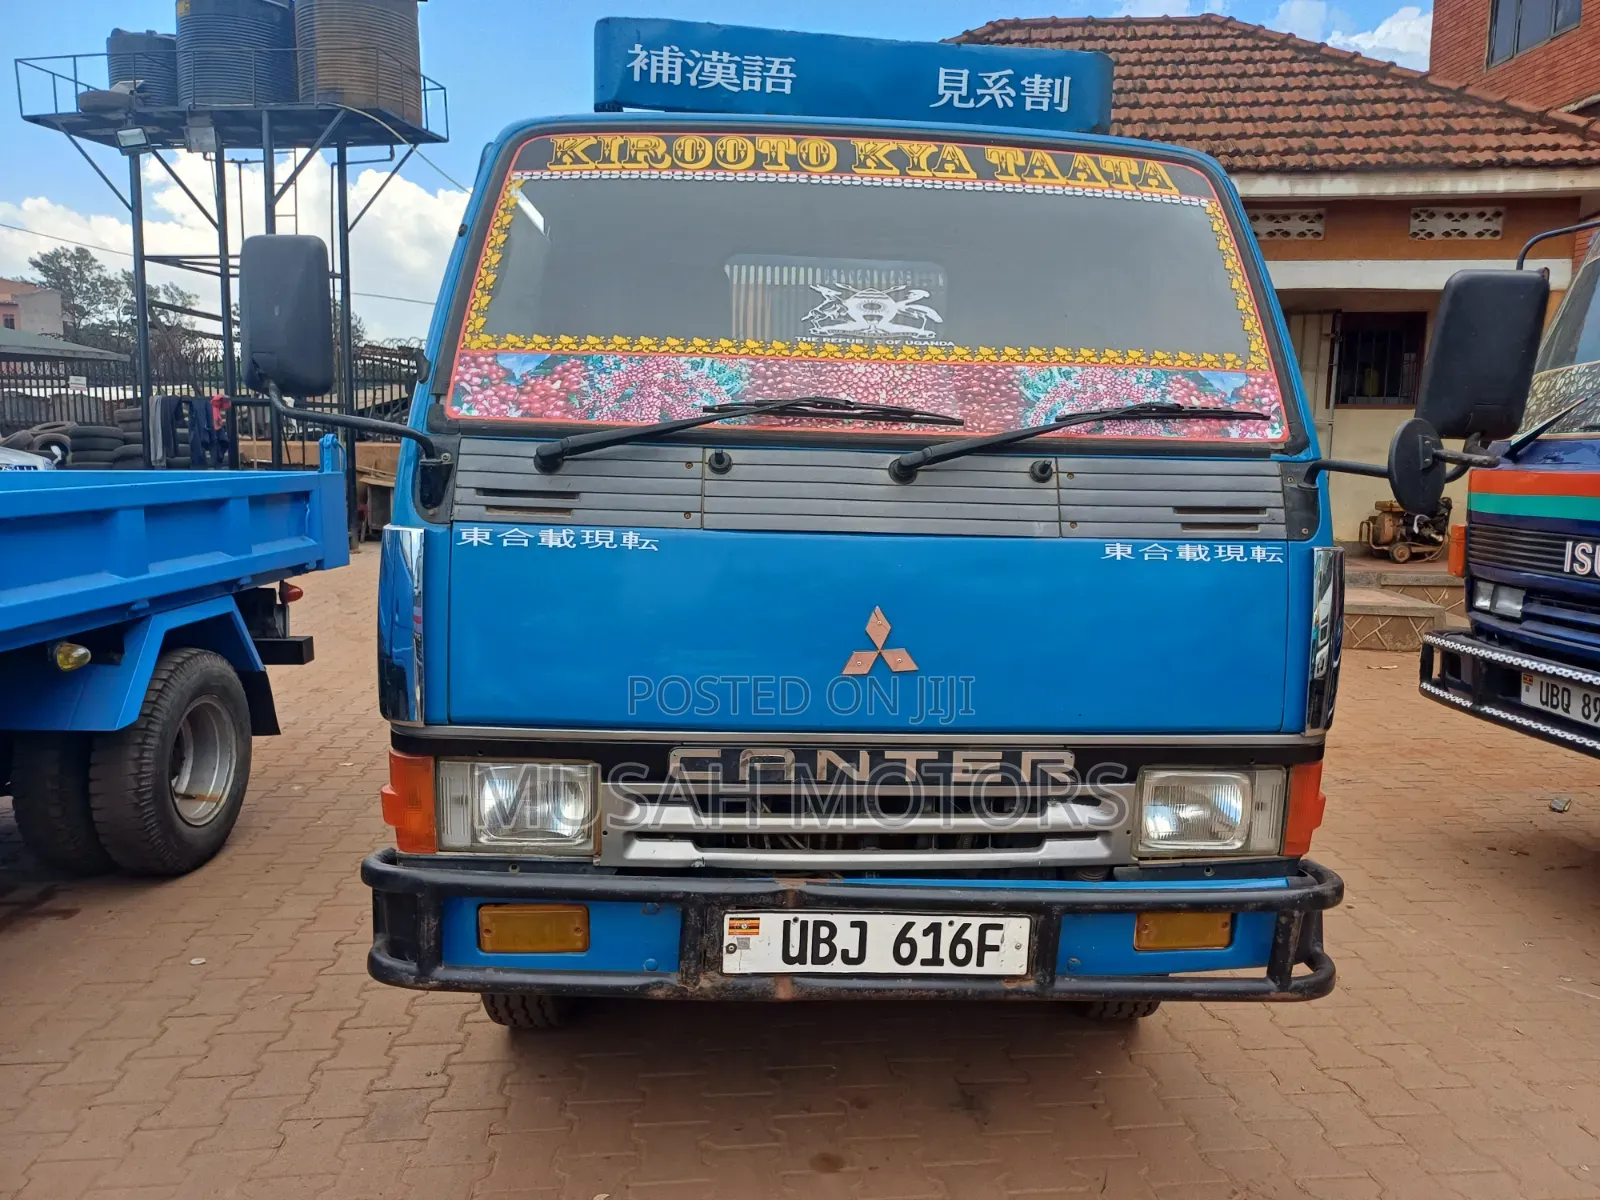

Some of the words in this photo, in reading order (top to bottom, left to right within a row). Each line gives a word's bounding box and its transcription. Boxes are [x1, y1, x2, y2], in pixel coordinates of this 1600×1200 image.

[626, 43, 797, 95] 補漢語
[929, 66, 1072, 113] 見系割
[547, 135, 837, 173] KIROOTO
[850, 139, 978, 179] KYA
[985, 146, 1181, 195] TAATA
[822, 336, 883, 344] REPUBC
[905, 339, 955, 347] UGANDA
[456, 526, 660, 551] 東合載現転
[1101, 542, 1284, 564] 東合載現転
[1539, 679, 1572, 715] UBQ
[668, 748, 1075, 782] CANTER
[781, 919, 868, 966] UBJ
[892, 921, 1004, 968] 616F
